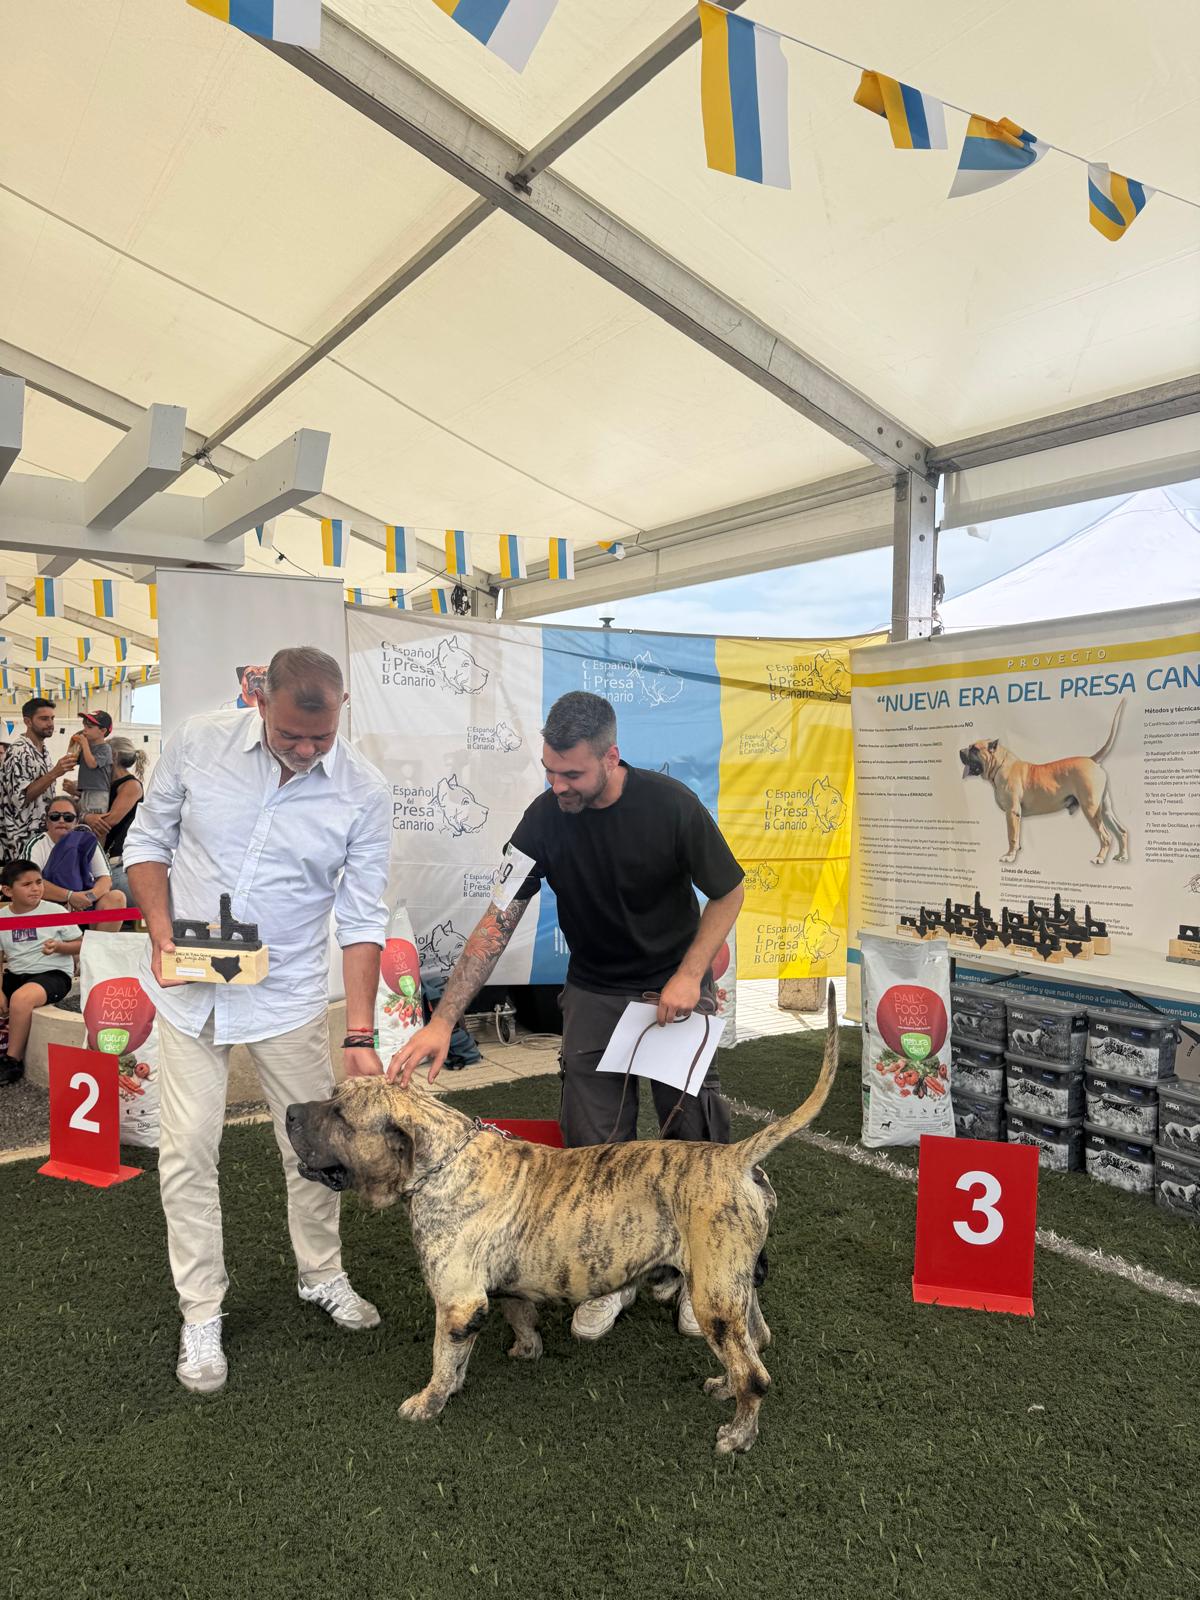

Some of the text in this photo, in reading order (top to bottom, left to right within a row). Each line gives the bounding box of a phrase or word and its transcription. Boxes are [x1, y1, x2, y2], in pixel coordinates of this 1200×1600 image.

[392, 644, 435, 659] Español
[1007, 649, 1106, 668] PROYECTO
[394, 657, 435, 676] Presa
[593, 660, 634, 672] Español
[776, 662, 812, 673] Español
[392, 672, 436, 688] Canario
[594, 675, 634, 689] Presa
[779, 676, 814, 688] Presa
[779, 689, 815, 700] Canario
[958, 685, 1000, 707] ERA
[1007, 681, 1051, 703] DEL
[1060, 673, 1136, 699] PRESA
[473, 734, 495, 743] Presa
[472, 742, 495, 750] Canario
[393, 785, 434, 798] Español
[775, 789, 809, 801] Español
[393, 803, 435, 817] Presa
[765, 788, 774, 831] CLUB
[774, 804, 808, 817] Presa
[392, 817, 435, 832] Canario
[773, 818, 808, 831] Canario
[470, 873, 492, 881] Español
[469, 882, 491, 891] Presa
[469, 890, 491, 898] Canario
[767, 923, 801, 936] Español
[754, 925, 766, 963] CLUB
[766, 939, 798, 950] Presa
[763, 951, 797, 963] Canario
[105, 986, 141, 998] DAILY
[894, 991, 926, 1004] DAILY
[1006, 981, 1038, 993] identitario
[1044, 988, 1056, 996] que
[1057, 989, 1075, 998] nadie
[1077, 993, 1094, 1001] ajeno
[1100, 996, 1129, 1007] Canarias
[102, 998, 138, 1010] FOOD
[895, 1003, 929, 1016] FOOD
[69, 1072, 100, 1134] 2
[953, 1170, 1004, 1245] 3
